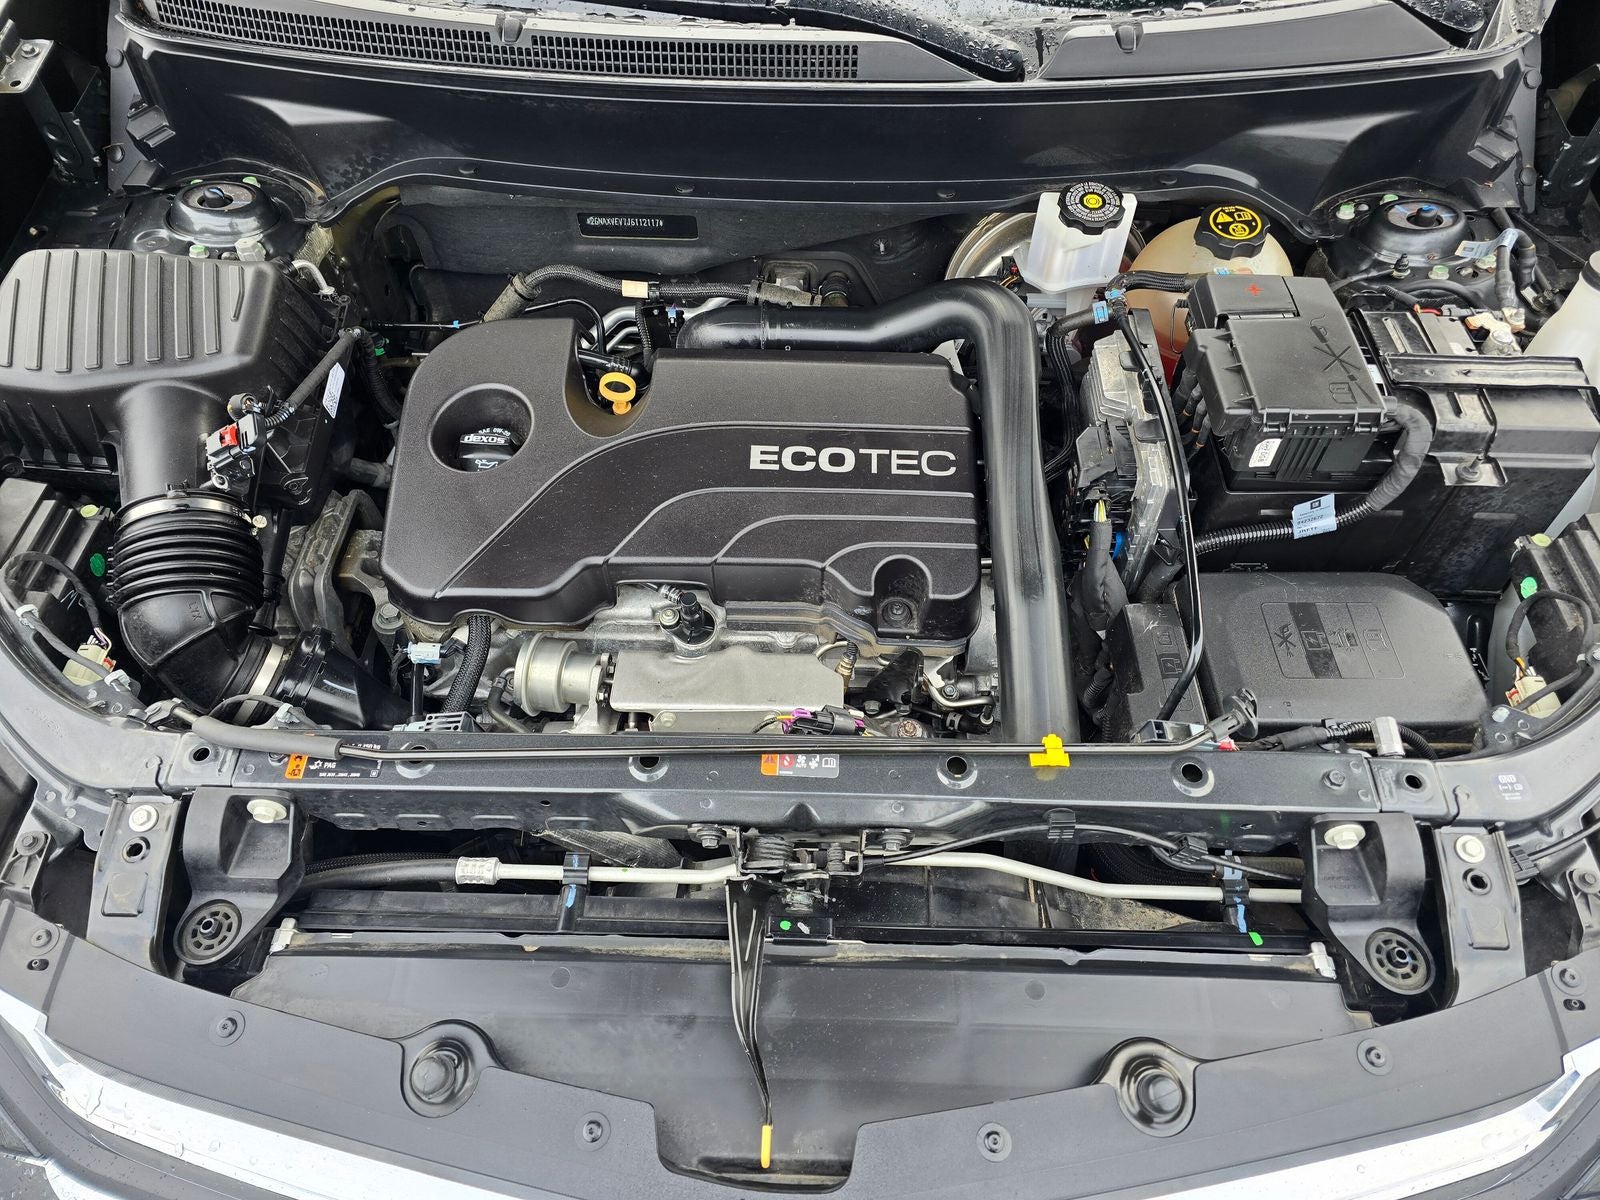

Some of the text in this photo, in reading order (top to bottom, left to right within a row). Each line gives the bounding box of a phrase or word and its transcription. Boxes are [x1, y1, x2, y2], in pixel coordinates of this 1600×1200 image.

[463, 434, 507, 444] dexos
[749, 444, 957, 477] ECOTEC
[1497, 774, 1517, 784] GND
